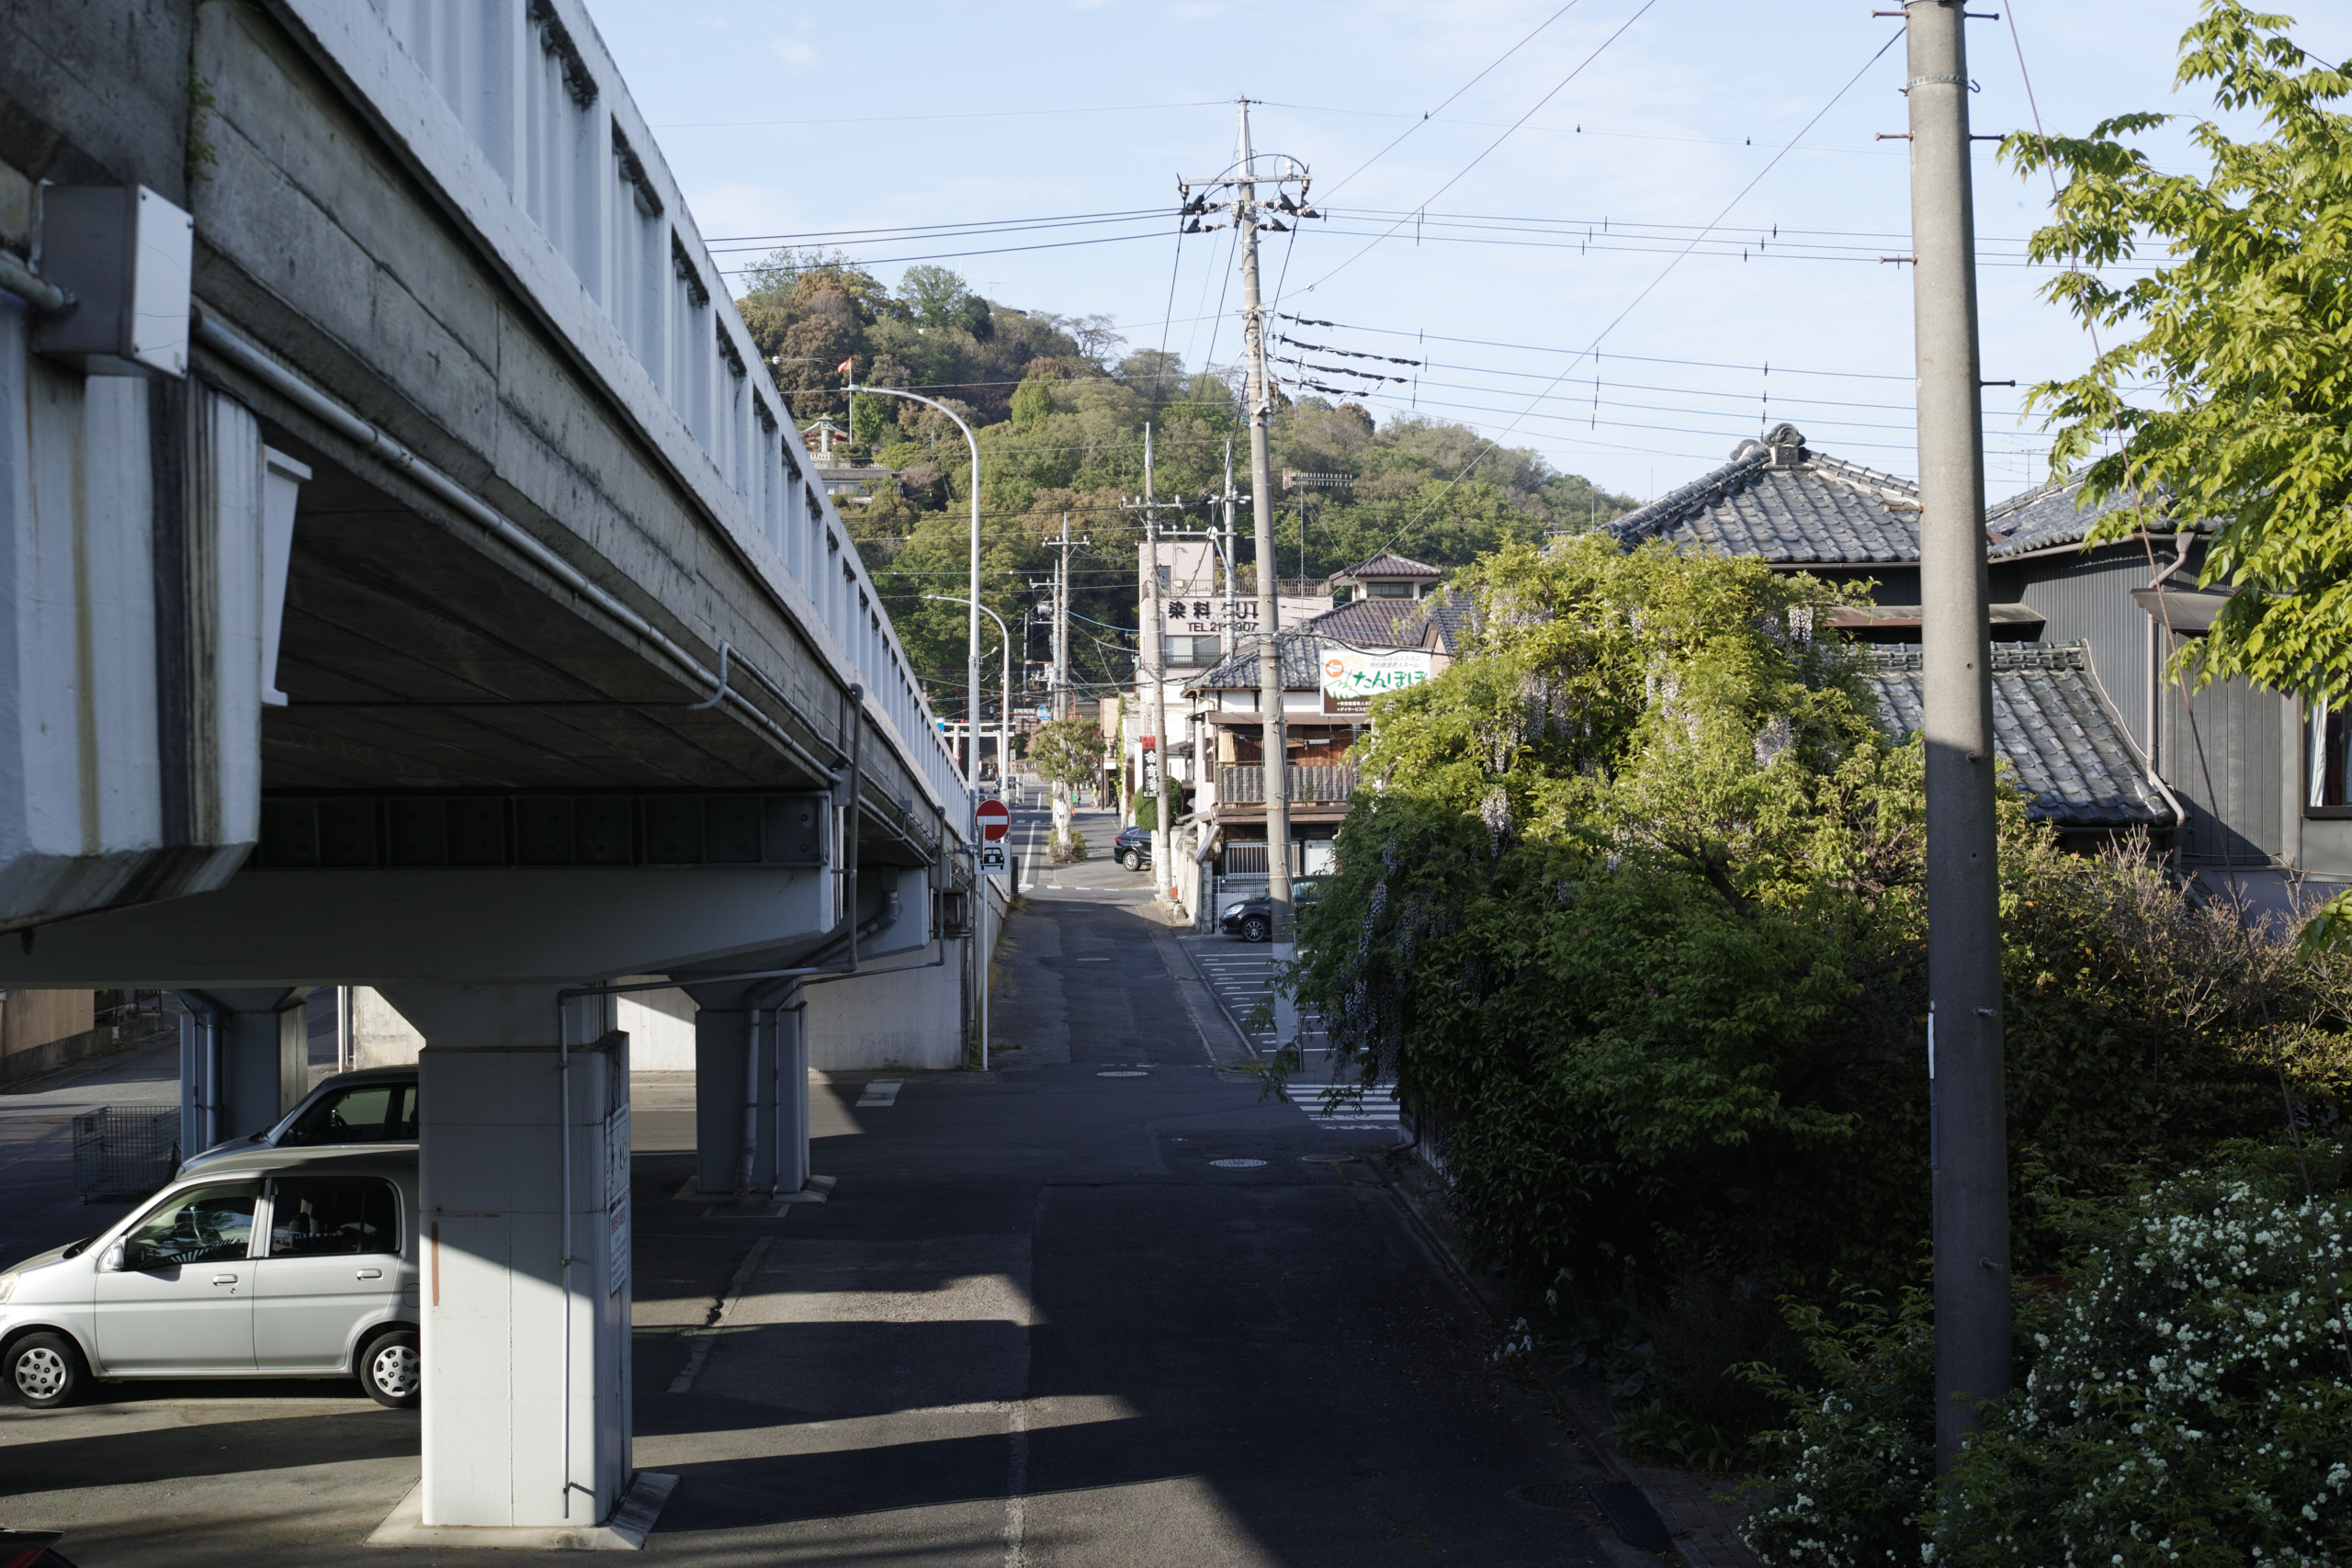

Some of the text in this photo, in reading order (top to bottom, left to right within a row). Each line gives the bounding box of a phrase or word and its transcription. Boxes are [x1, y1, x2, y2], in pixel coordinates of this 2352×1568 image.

[1169, 600, 1211, 619] 染料
[1352, 670, 1428, 689] たんぽぽ
